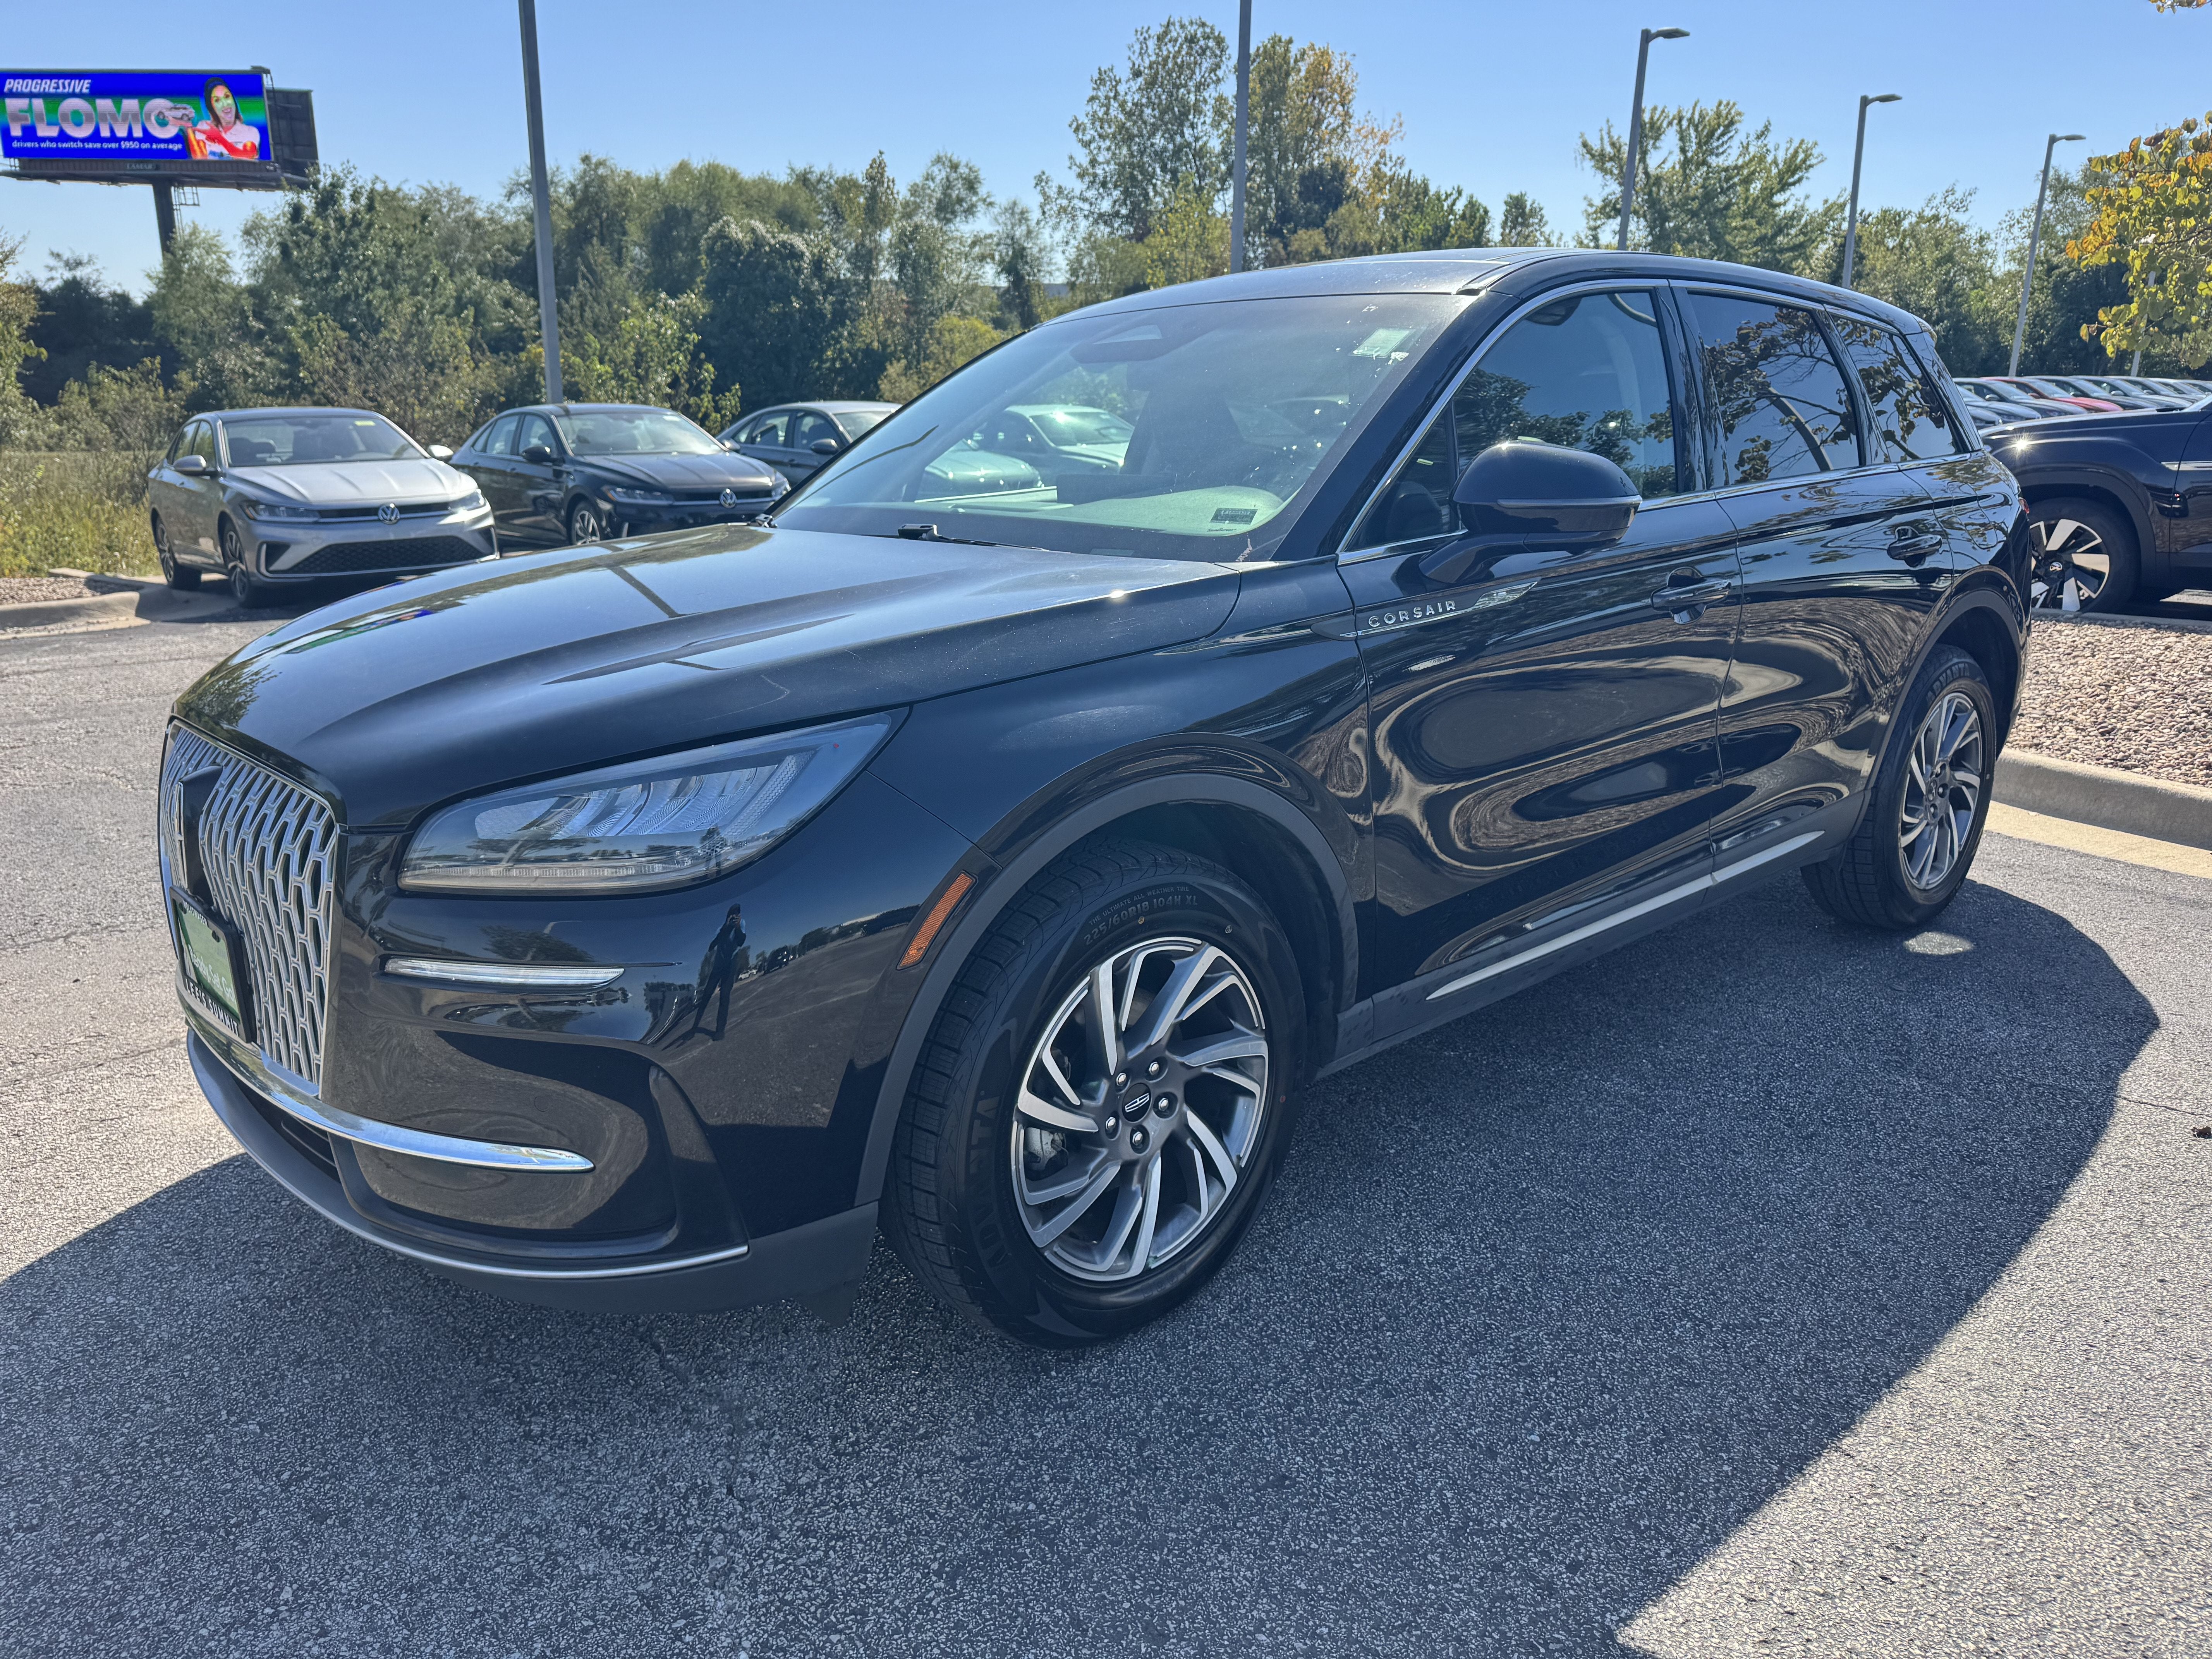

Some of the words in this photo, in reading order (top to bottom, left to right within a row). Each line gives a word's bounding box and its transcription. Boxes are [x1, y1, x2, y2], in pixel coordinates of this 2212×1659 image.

[3, 79, 91, 93] PROGRESSIVE
[5, 98, 181, 139] FLOMO
[12, 139, 38, 148] drivers
[40, 139, 57, 148] who
[58, 139, 83, 148] switch
[120, 141, 139, 149] $950
[1369, 600, 1456, 627] CORSAIR
[1926, 663, 1970, 706] ADVANTA
[1084, 902, 1149, 946] 225/60R18
[1153, 895, 1181, 909] 104H
[1185, 895, 1198, 906] XL
[1089, 916, 1101, 926] THE
[1103, 898, 1132, 917] ULTIMATE
[1147, 886, 1174, 896] WEATHER
[185, 978, 207, 1008] LEE'S
[208, 998, 239, 1037] SUMMIT
